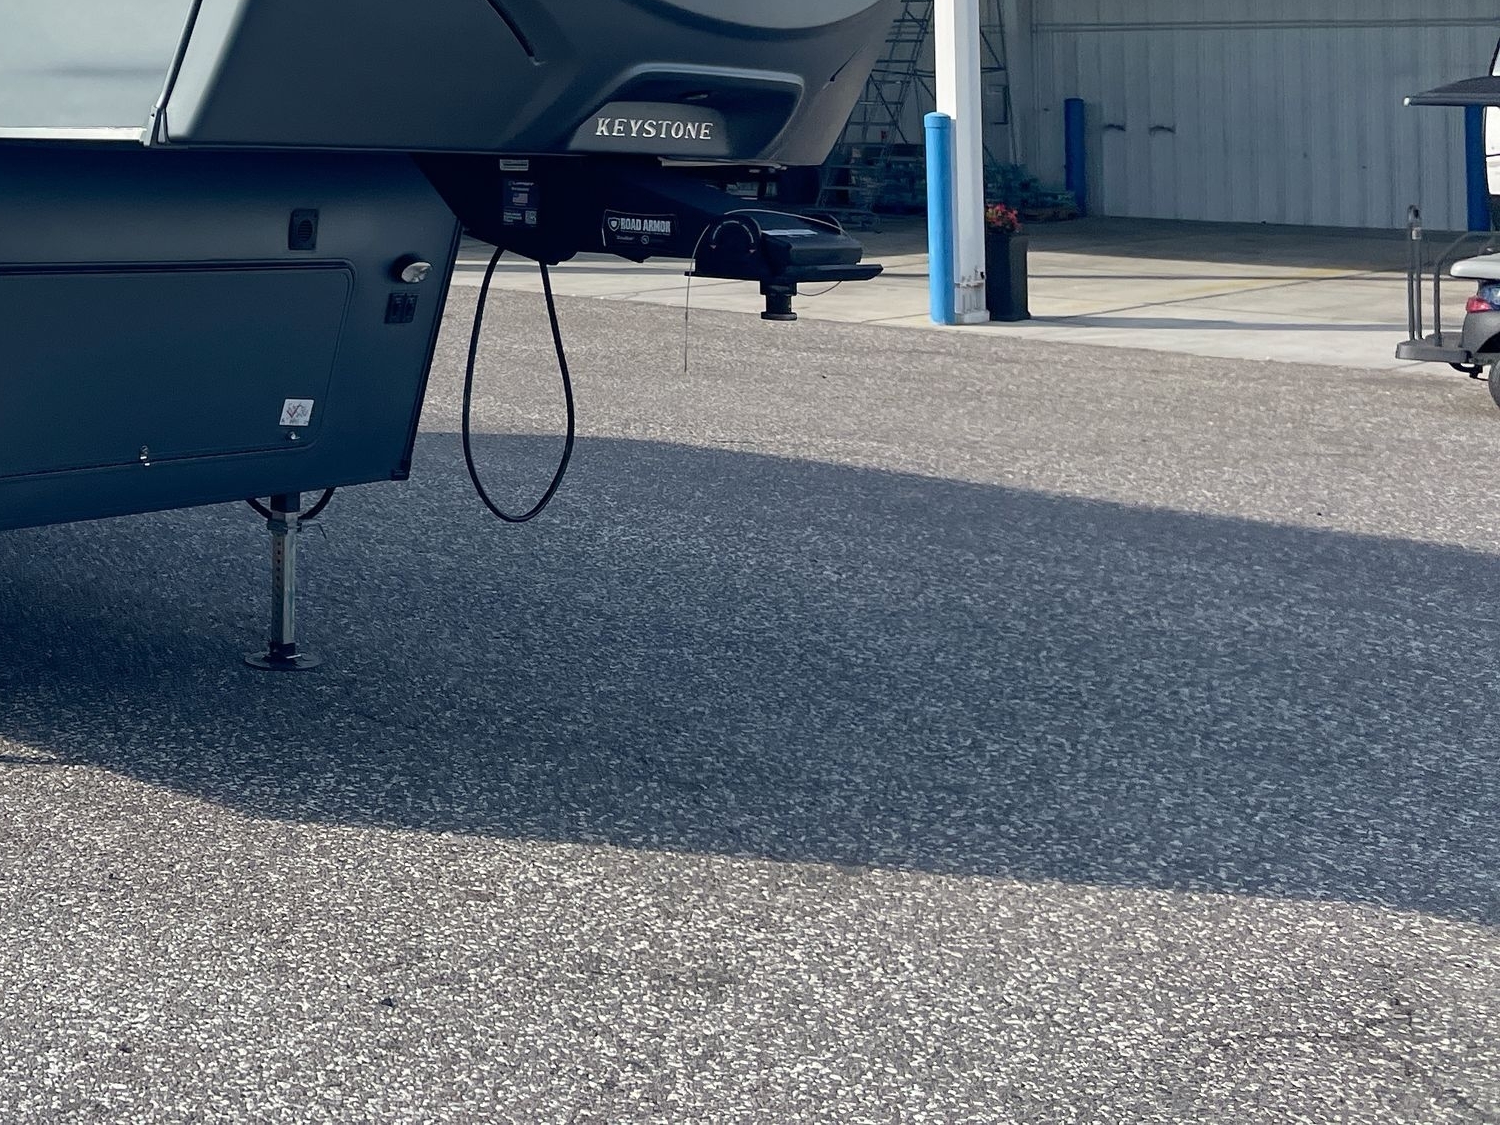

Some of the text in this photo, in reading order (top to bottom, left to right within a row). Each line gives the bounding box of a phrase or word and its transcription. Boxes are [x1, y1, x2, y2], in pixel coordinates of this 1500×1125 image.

[595, 117, 714, 140] KEYSTONE
[620, 217, 642, 231] ROAD
[642, 219, 671, 233] ARMOR
